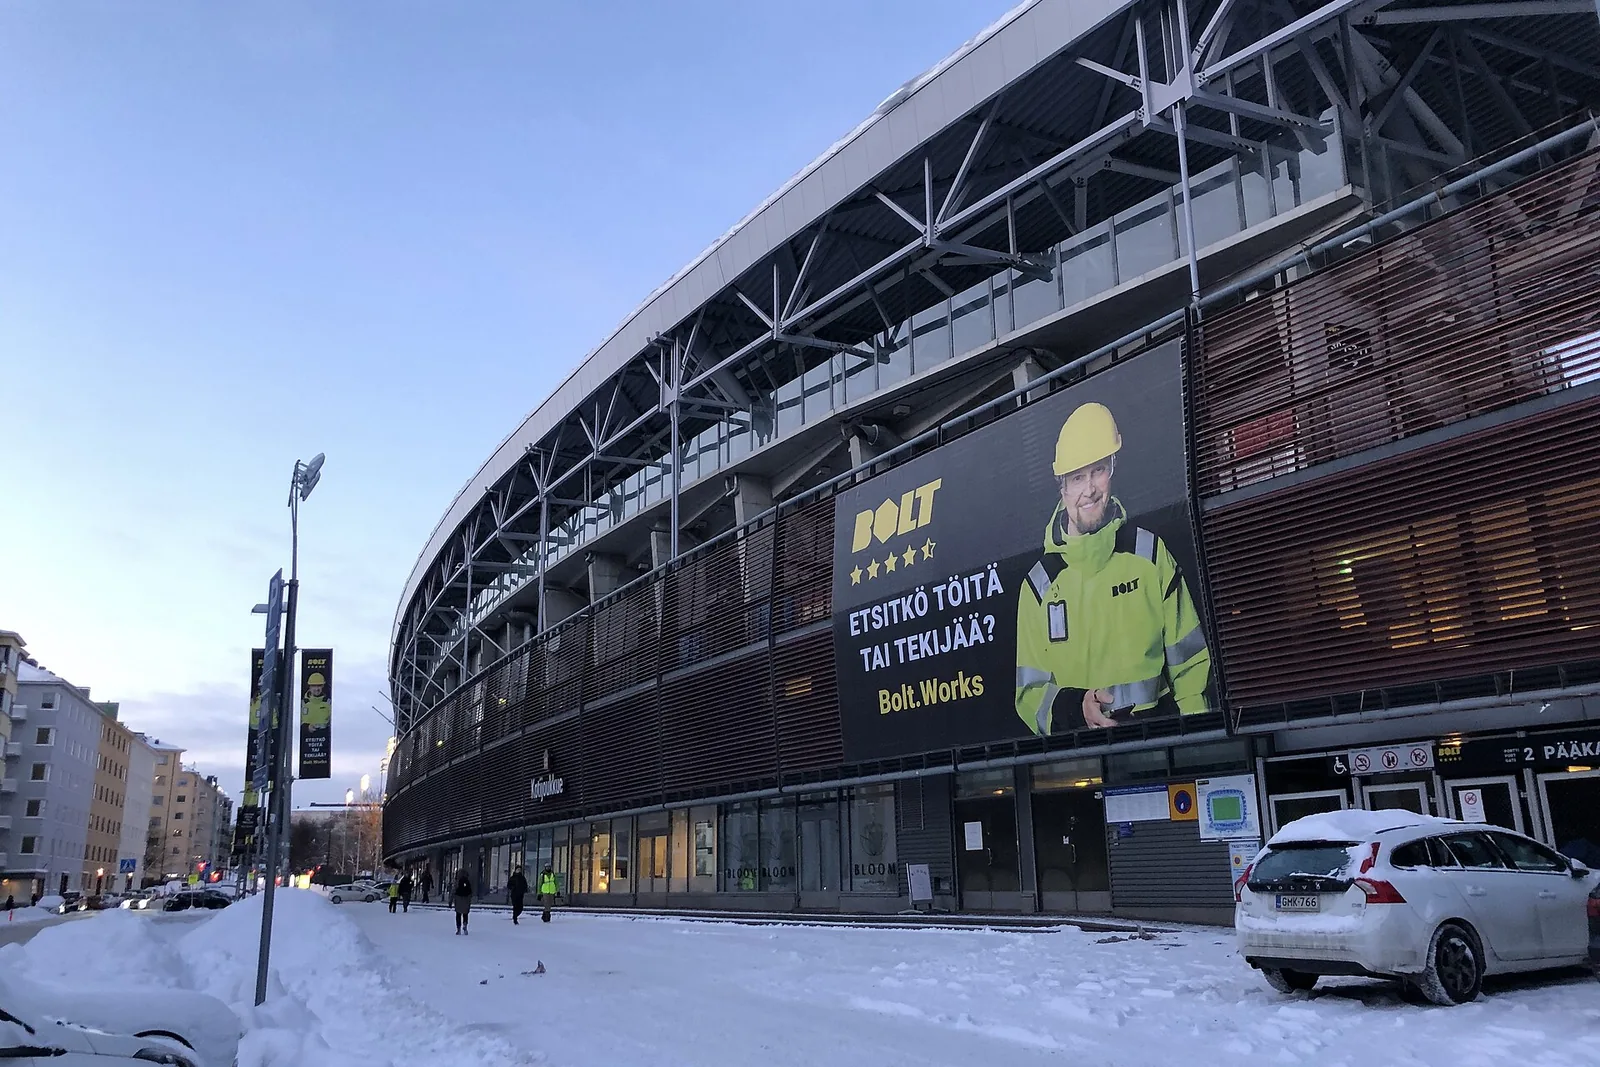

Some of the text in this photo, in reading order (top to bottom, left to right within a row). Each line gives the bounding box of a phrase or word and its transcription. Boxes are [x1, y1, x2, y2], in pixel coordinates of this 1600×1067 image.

[851, 477, 942, 553] BOLT
[1111, 577, 1140, 598] BOLT
[849, 562, 1004, 636] ETSITKÖ TÖITÄ
[859, 612, 996, 672] TAI TEKIJÄÄ?
[878, 671, 985, 715] Bolt.Works
[1438, 747, 1461, 756] BOLT
[1523, 747, 1535, 761] 2
[761, 866, 795, 878] BLOOM
[854, 862, 897, 876] BLOOM
[1281, 897, 1317, 907] GMK-766
